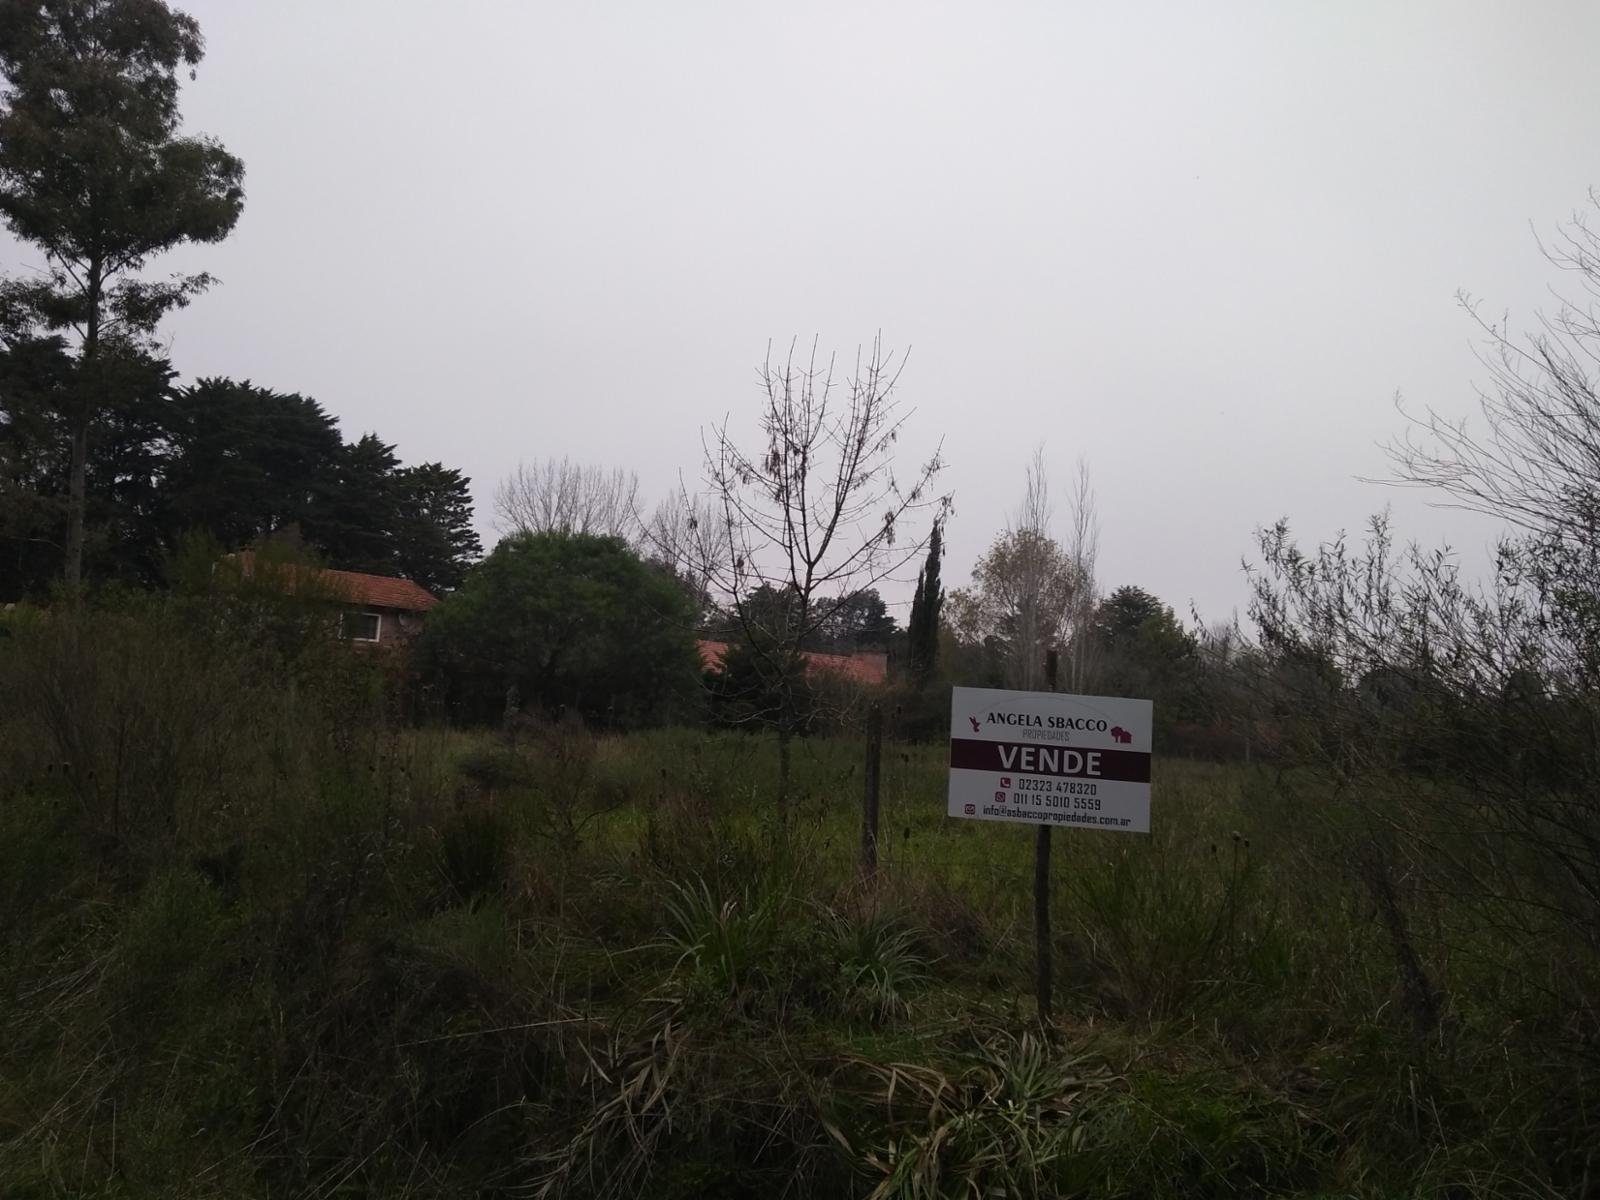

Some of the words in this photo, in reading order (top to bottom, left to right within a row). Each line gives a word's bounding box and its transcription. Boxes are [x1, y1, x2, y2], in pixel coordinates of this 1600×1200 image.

[986, 712, 1042, 727] ANGELA
[1047, 716, 1108, 732] SBACCO
[1022, 729, 1070, 742] PROPIEDADES
[998, 745, 1102, 776] VENDE
[1018, 779, 1052, 792] 02323
[1056, 782, 1097, 796] 478320
[1013, 792, 1028, 805] 011
[1032, 794, 1042, 806] 15
[1045, 795, 1070, 808] 5010
[1074, 797, 1101, 810] 5559
[983, 805, 1132, 827] info@asbaccopropiedades.com.ar
